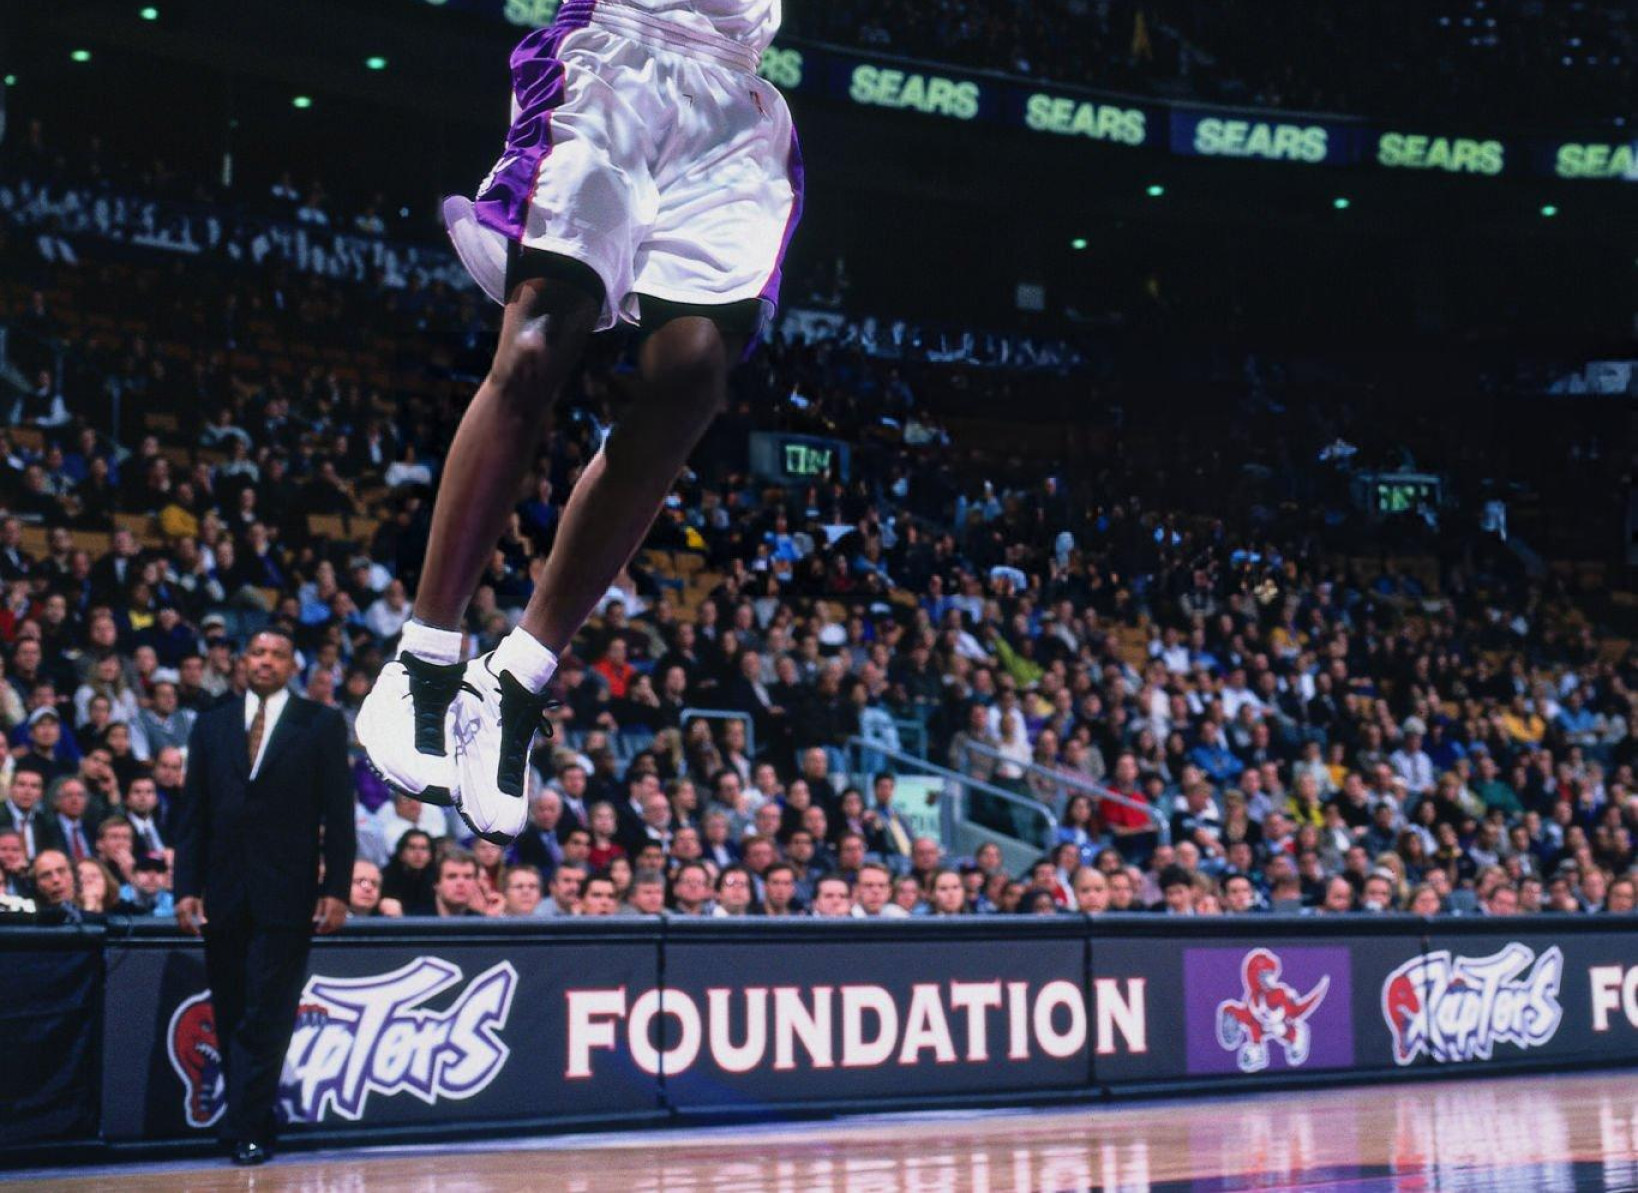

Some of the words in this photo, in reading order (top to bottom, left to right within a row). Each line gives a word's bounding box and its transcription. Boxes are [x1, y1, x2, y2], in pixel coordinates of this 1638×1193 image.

[850, 64, 980, 120] SEARS
[1025, 93, 1146, 145] SEARS
[1194, 117, 1328, 163] SEARS
[1378, 132, 1504, 175] SEARS
[1556, 143, 1638, 179] SEA
[564, 977, 1148, 1079] FOUNDATION
